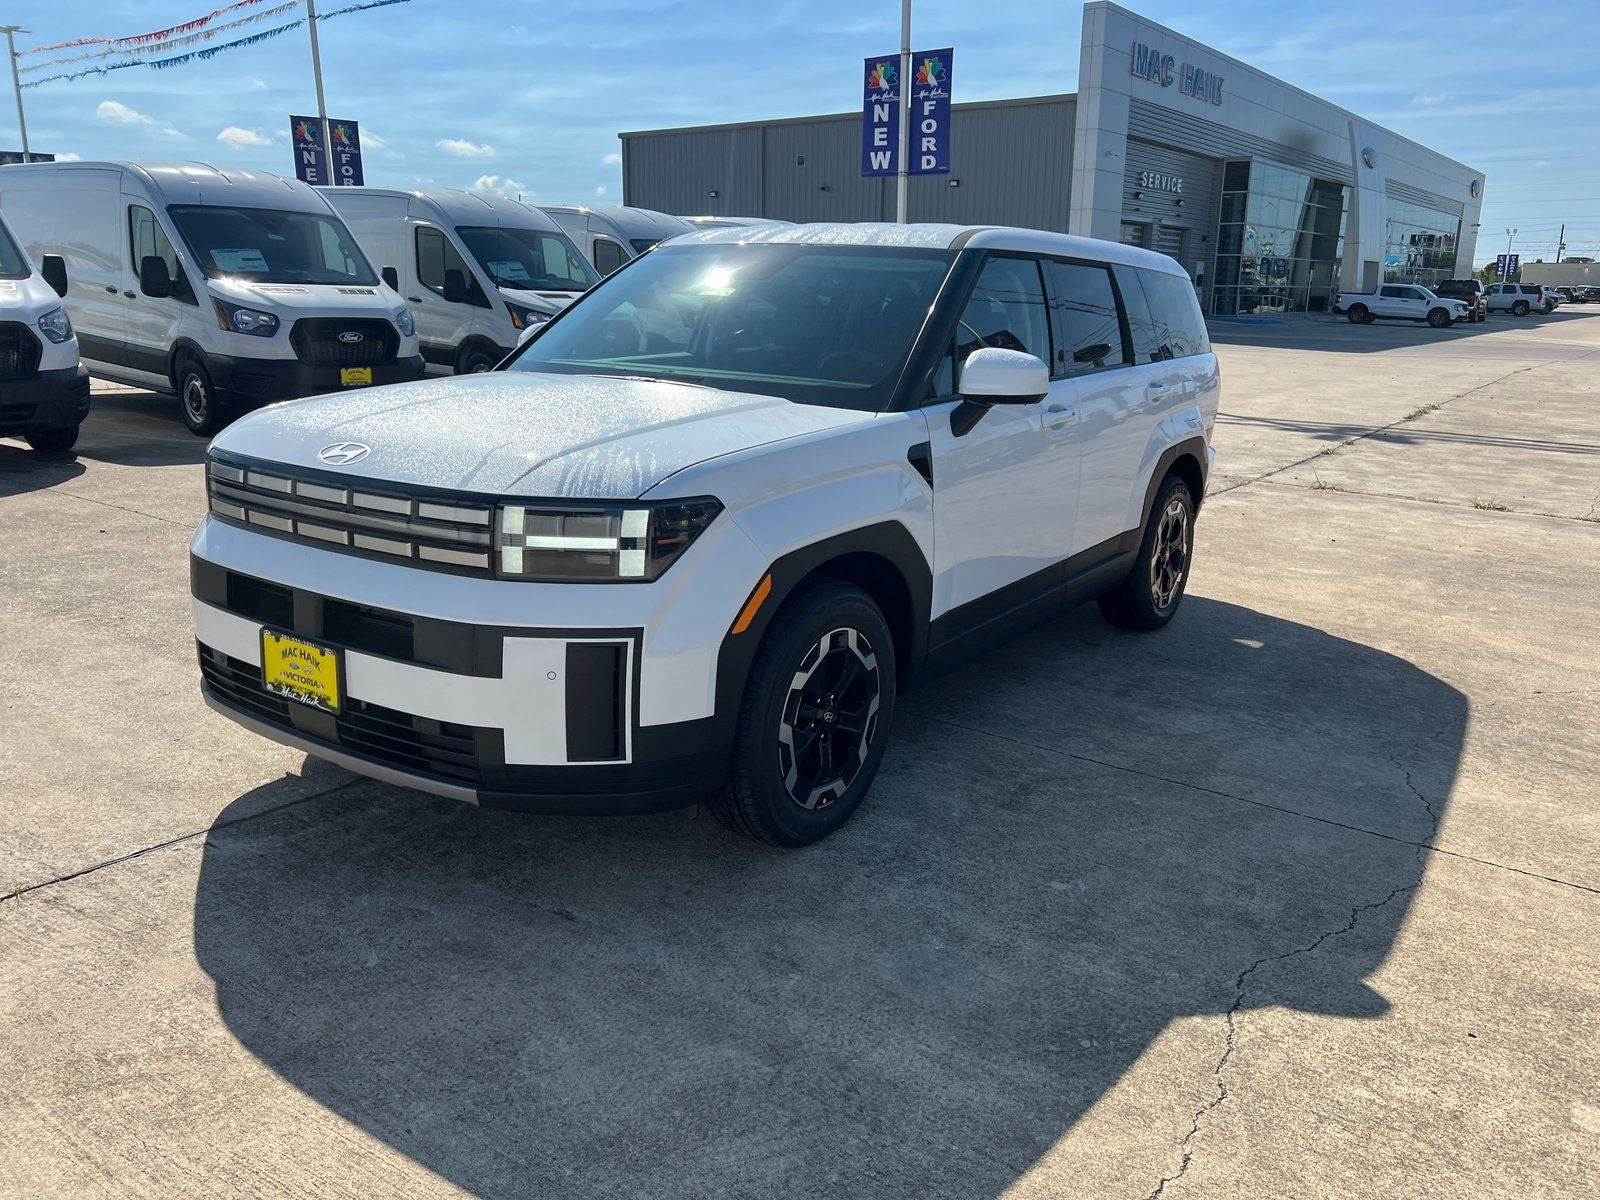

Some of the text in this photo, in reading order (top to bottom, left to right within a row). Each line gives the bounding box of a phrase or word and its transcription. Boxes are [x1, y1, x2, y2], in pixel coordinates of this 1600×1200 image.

[1131, 41, 1224, 106] MAC HAIK
[870, 104, 891, 170] NEW
[921, 101, 937, 170] FORD
[302, 150, 318, 182] NE
[341, 153, 354, 186] FOR
[1141, 171, 1182, 193] SERVICE
[342, 333, 360, 341] Ford
[281, 647, 321, 672] MAC HAIK
[286, 671, 319, 687] VICTORIA
[280, 687, 325, 707] Mac Haik
